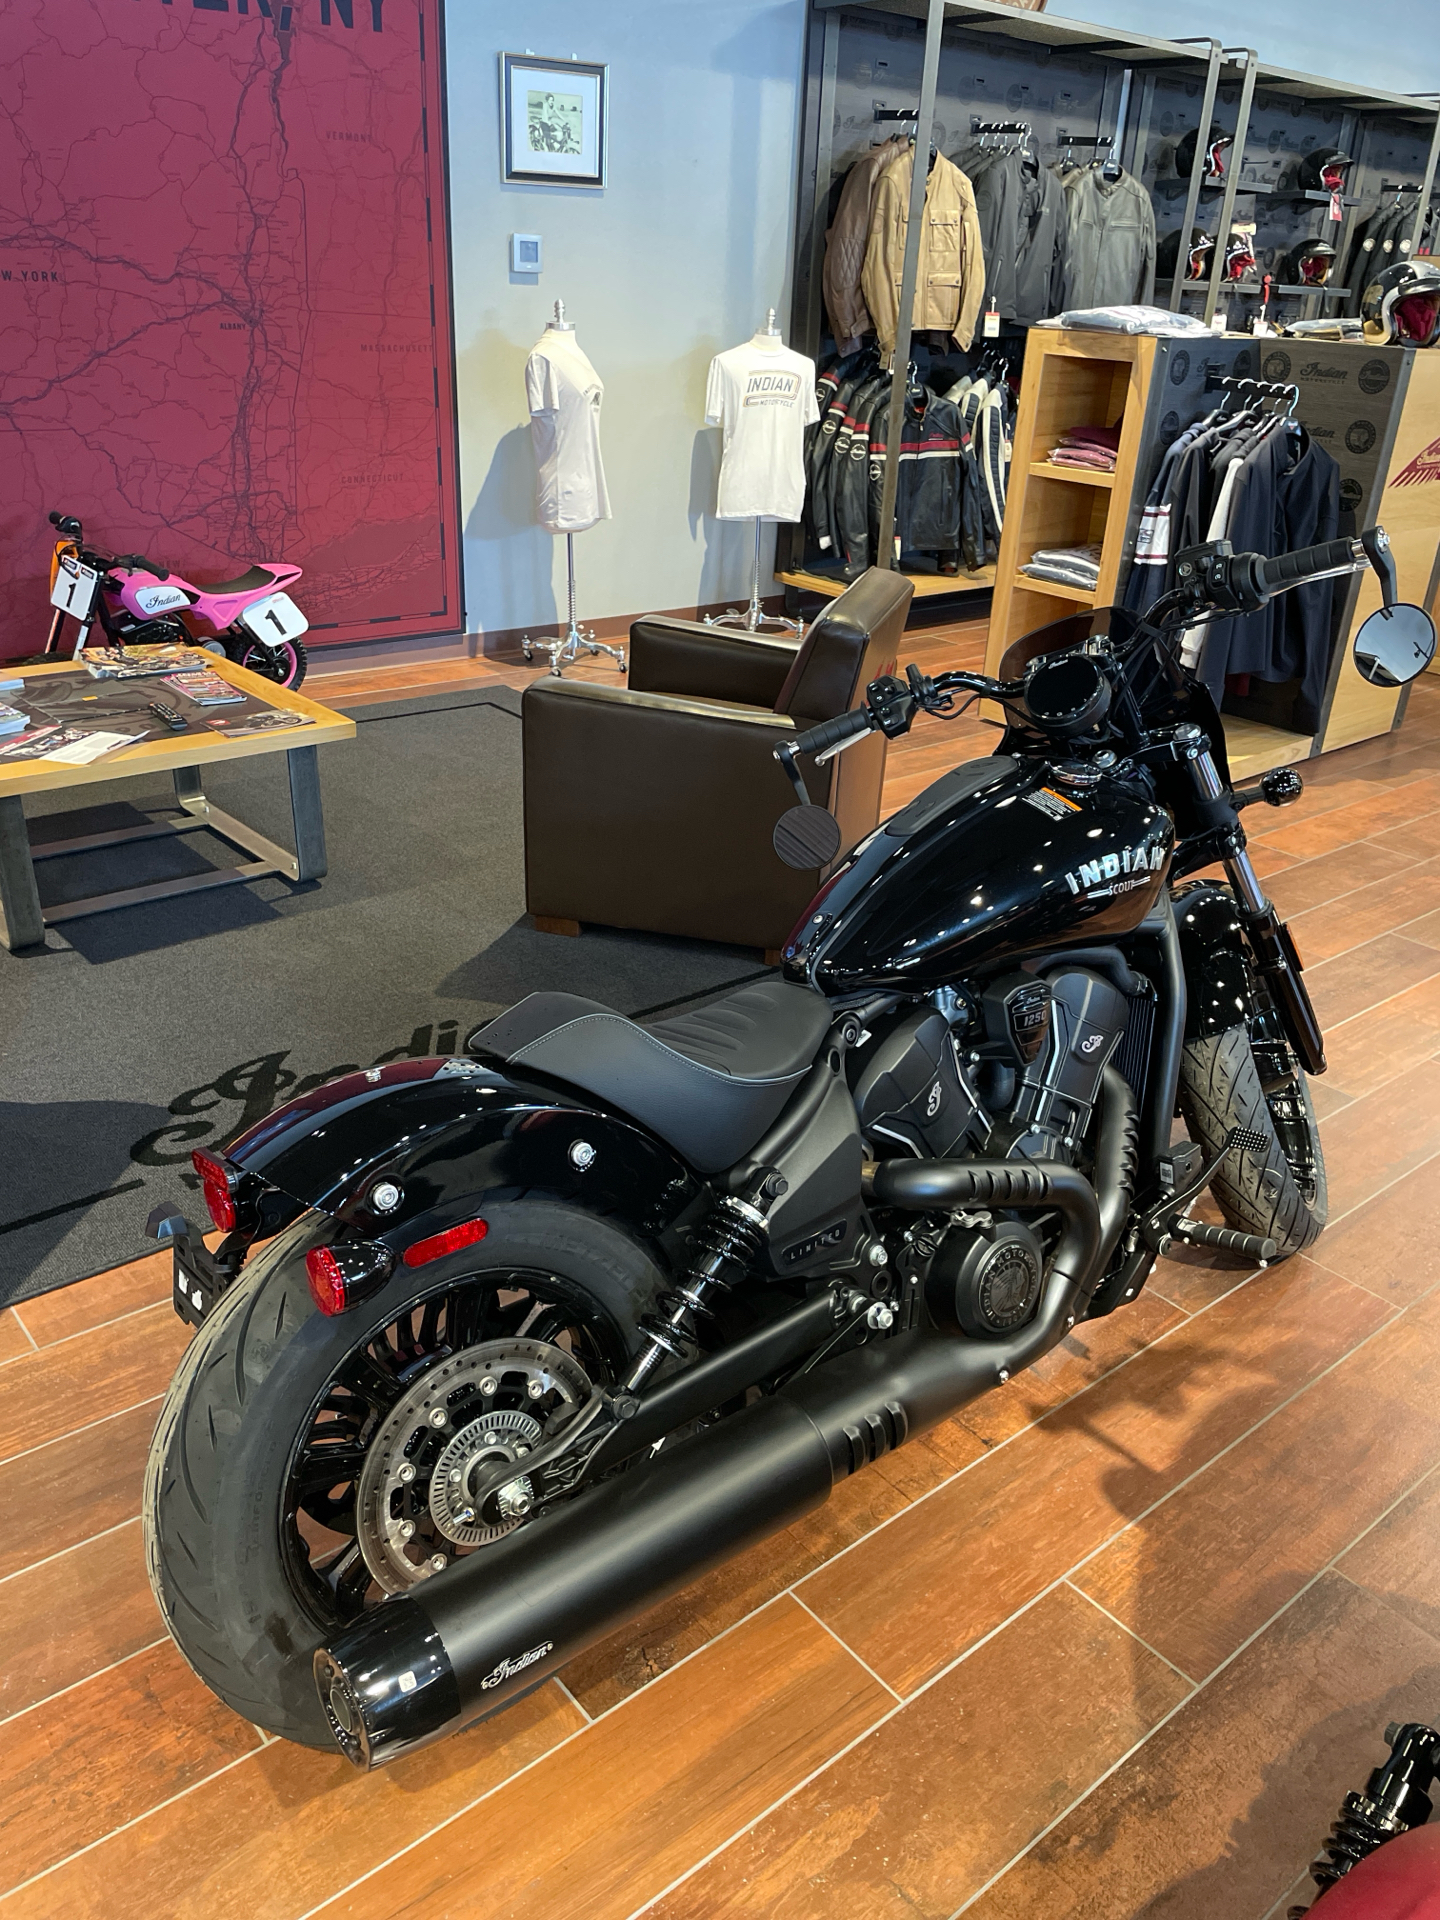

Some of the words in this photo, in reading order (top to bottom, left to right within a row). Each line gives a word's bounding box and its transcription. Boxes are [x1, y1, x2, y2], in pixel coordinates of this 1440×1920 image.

[21, 270, 60, 283] YORK
[220, 322, 246, 331] ALBANY
[1300, 362, 1348, 379] Indian
[747, 376, 794, 393] INDIAN
[341, 473, 404, 484] CONNECTICUT
[66, 582, 77, 608] 1
[145, 594, 181, 609] Indian
[264, 609, 288, 636] 1
[1065, 846, 1166, 895] INDIAN
[1109, 879, 1135, 896] SCOUT
[1023, 1010, 1047, 1027] 1250
[790, 1229, 841, 1260] LIMITED
[481, 1641, 554, 1690] Indian
